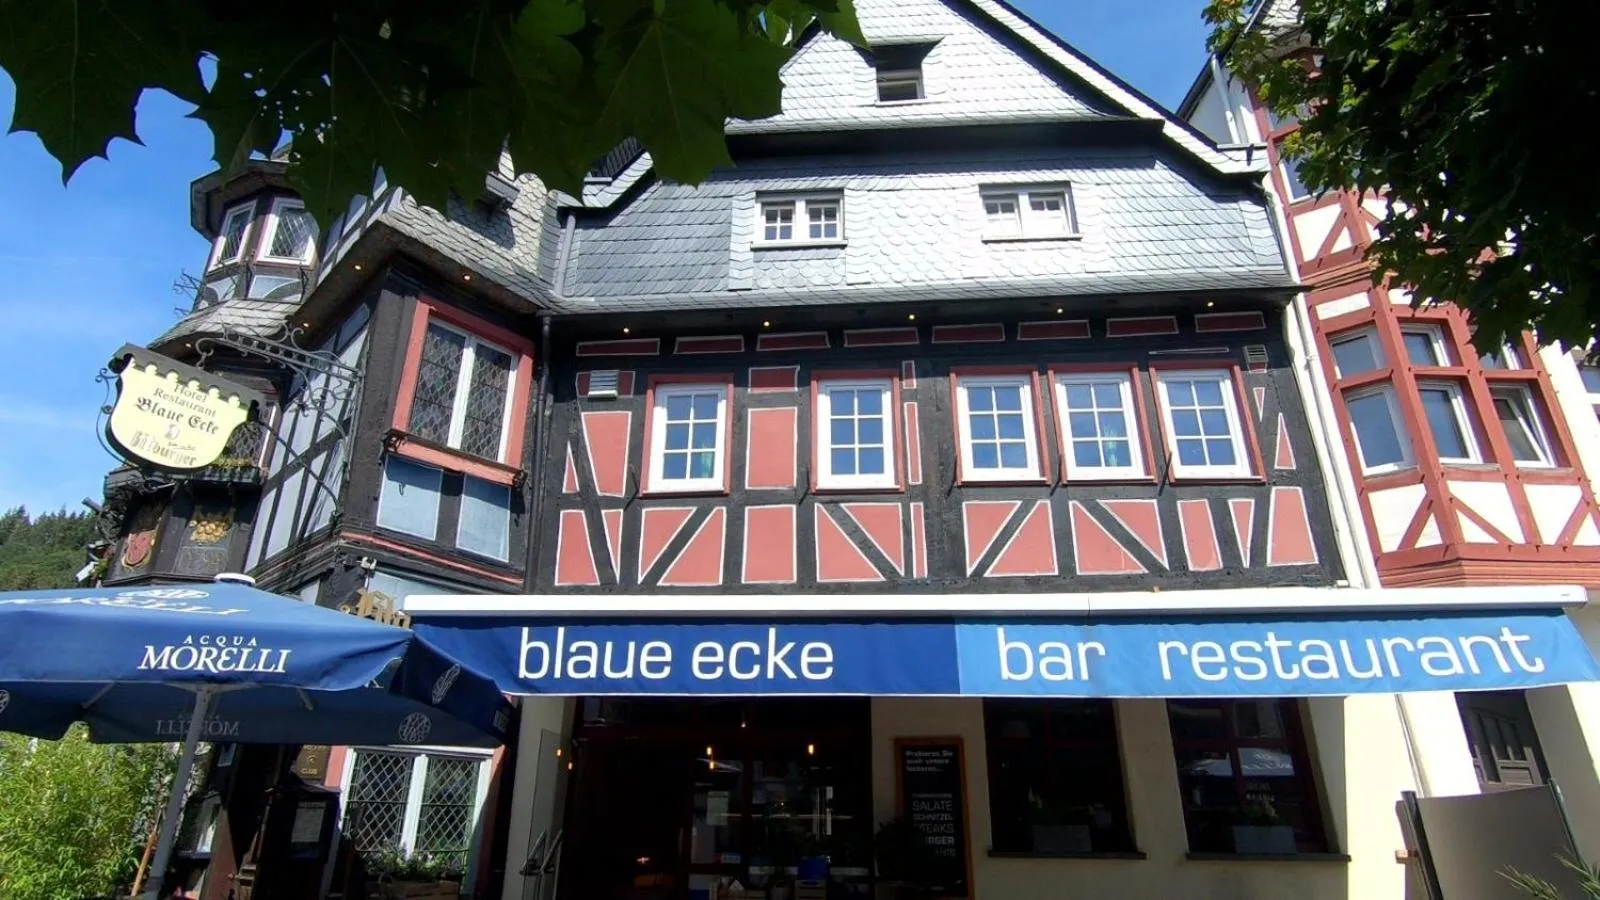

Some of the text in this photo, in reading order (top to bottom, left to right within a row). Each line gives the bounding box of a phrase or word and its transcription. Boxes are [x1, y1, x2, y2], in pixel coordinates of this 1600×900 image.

[153, 388, 217, 417] Restaurant
[173, 385, 208, 403] Hotel
[135, 396, 220, 435] Blaue Ecke
[184, 635, 257, 648] ACQUA
[518, 626, 834, 680] blaue ecke
[996, 626, 1546, 682] bar restaurant
[137, 645, 291, 674] MORELLI
[912, 800, 953, 811] SALATE
[917, 823, 954, 833] TEAKS
